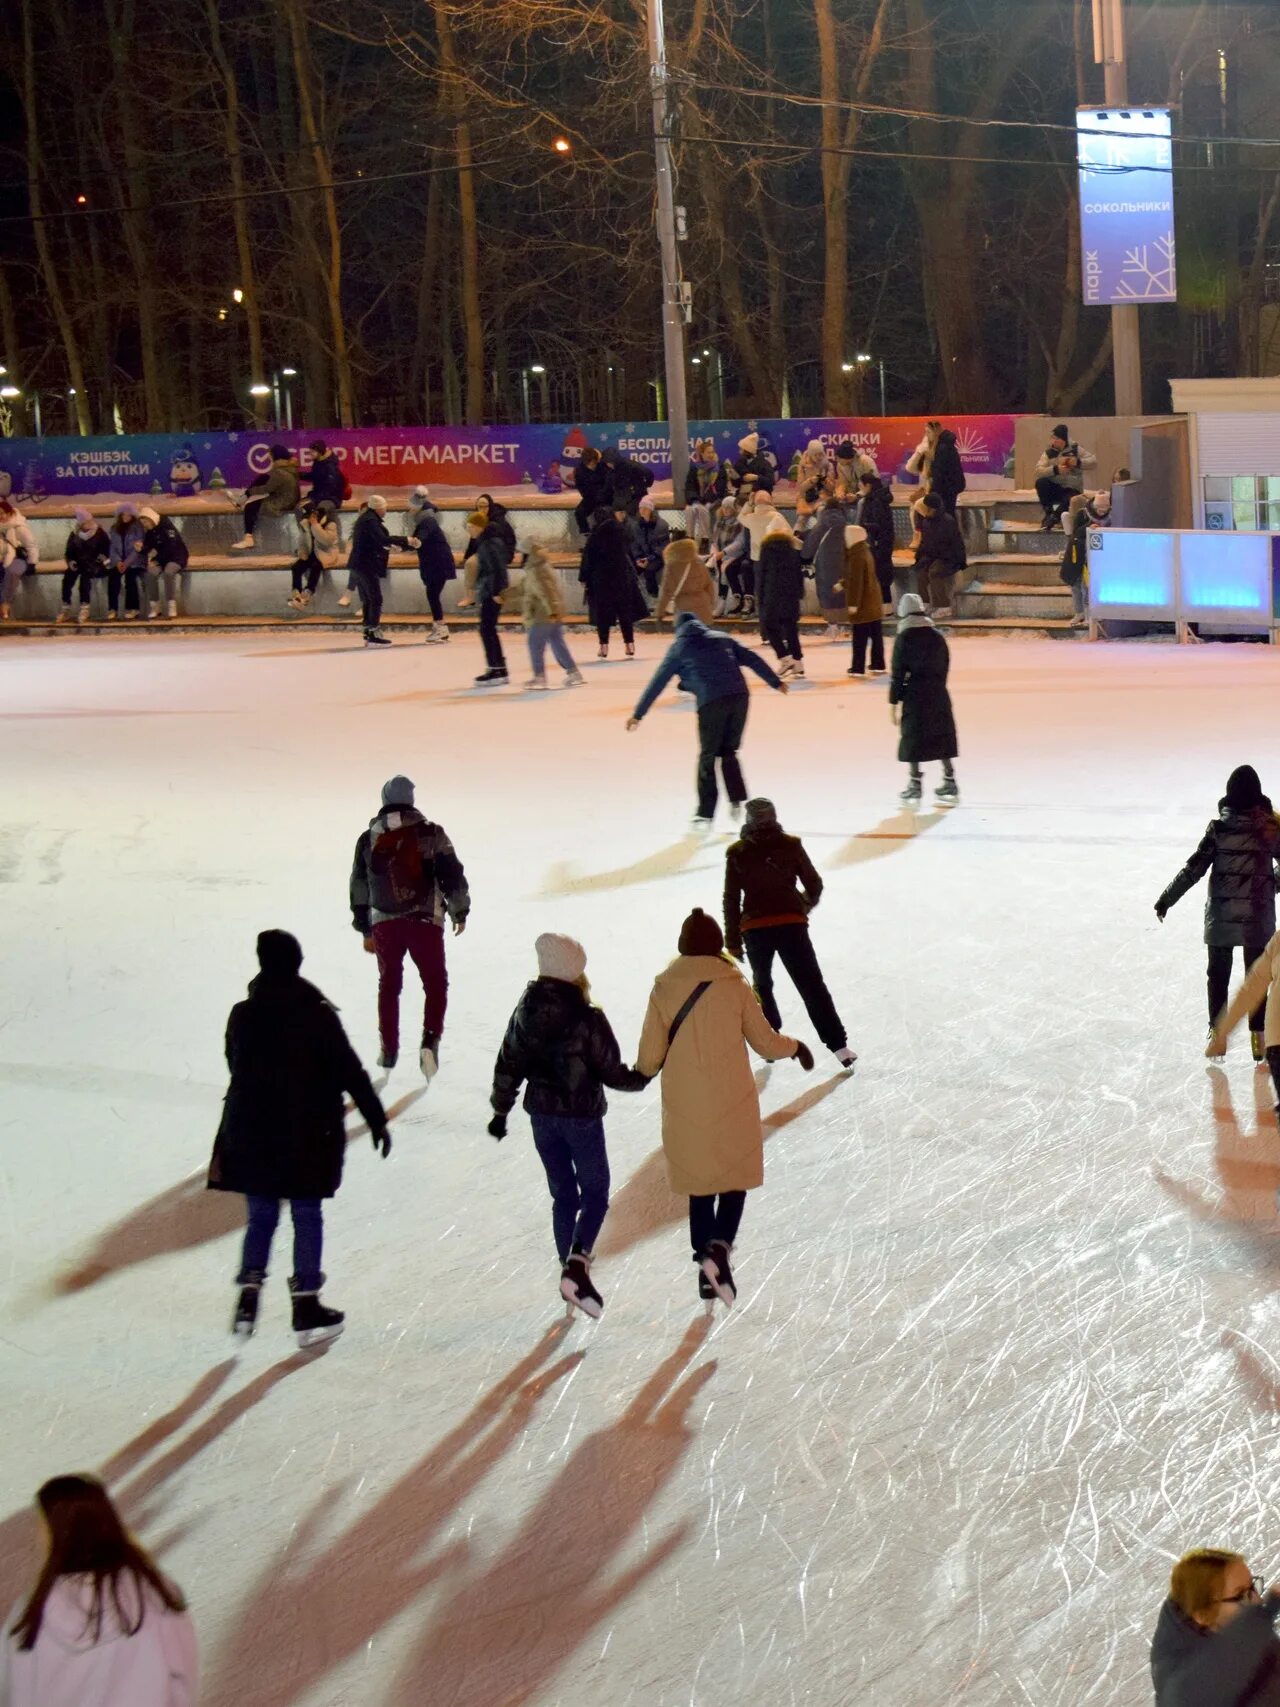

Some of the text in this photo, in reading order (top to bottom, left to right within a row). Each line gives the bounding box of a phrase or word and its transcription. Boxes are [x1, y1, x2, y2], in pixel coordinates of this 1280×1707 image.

[1084, 201, 1170, 213] СОКОЛЬНИКИ
[1086, 249, 1102, 300] парк
[70, 450, 132, 464] КЭШБЭК
[354, 444, 520, 465] МЕГАМАРКЕТ
[56, 464, 150, 478] ЗА ПОКУПКИ
